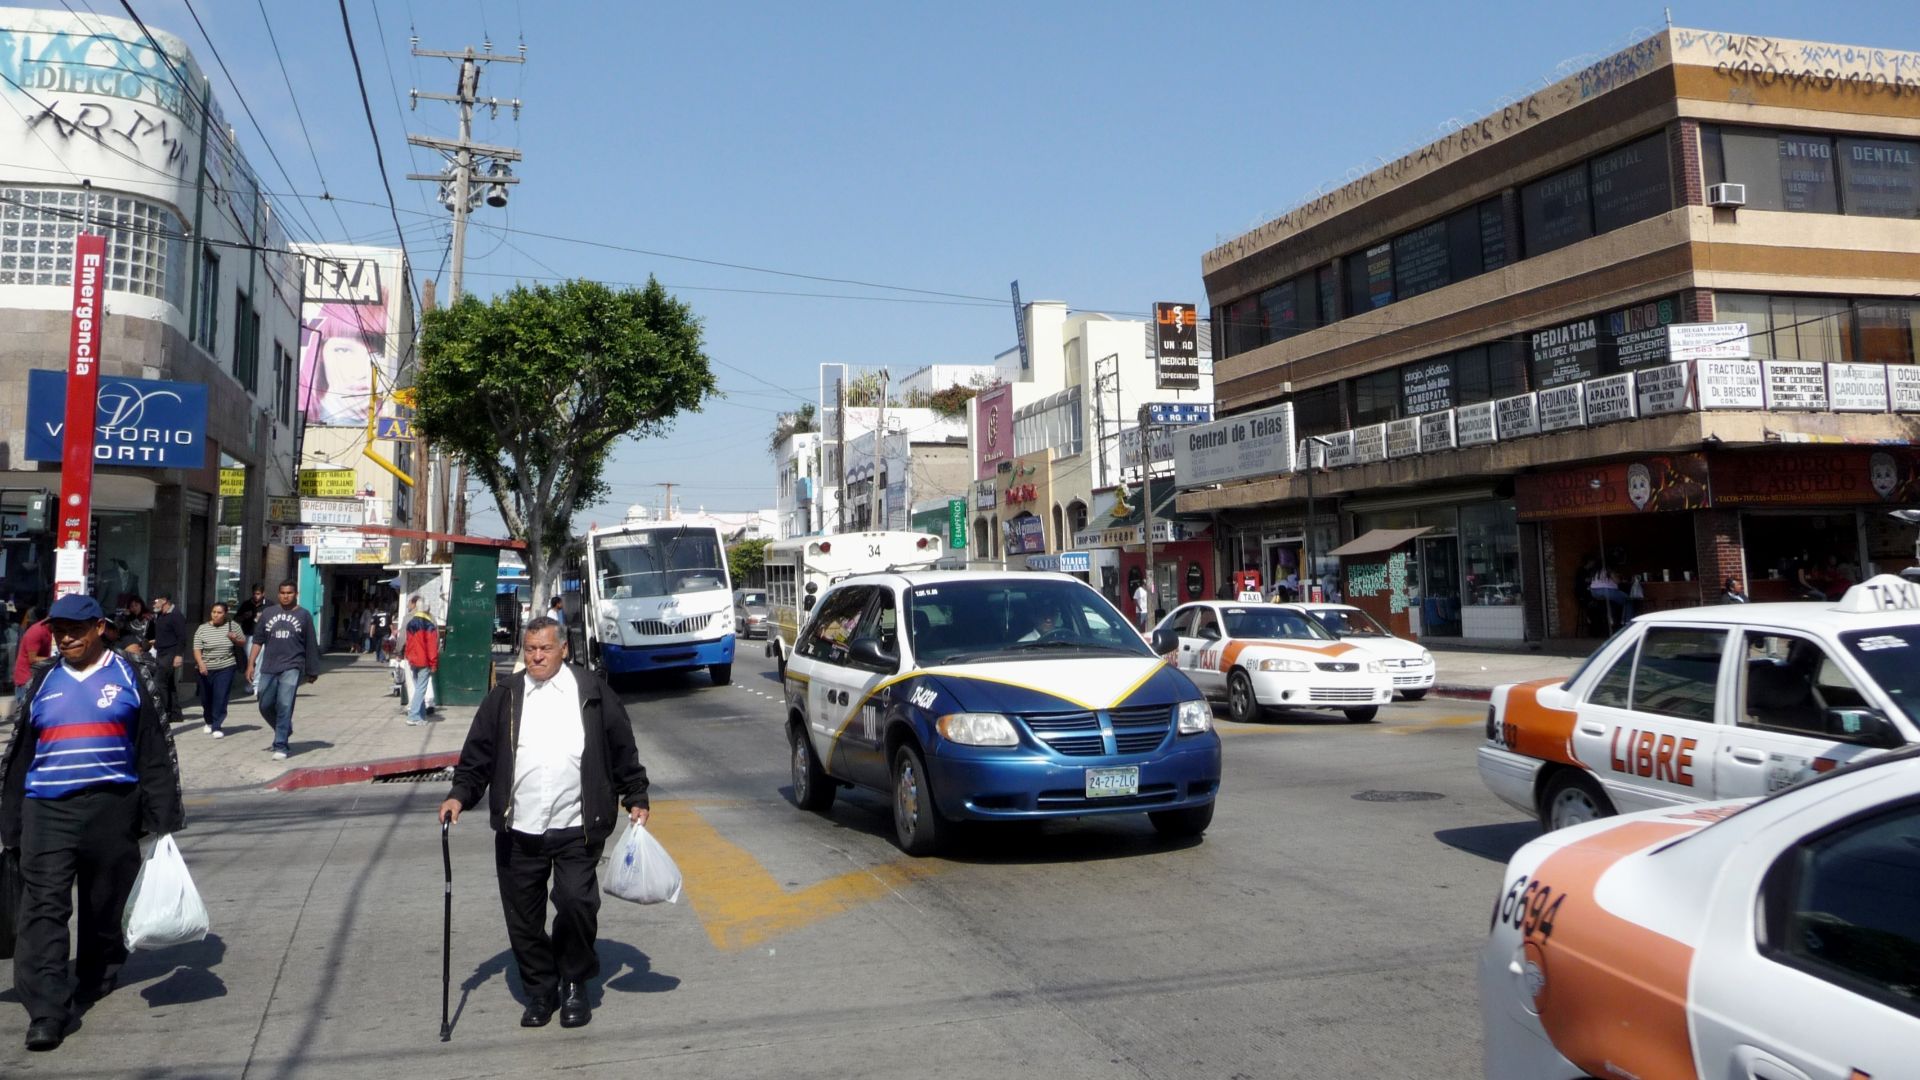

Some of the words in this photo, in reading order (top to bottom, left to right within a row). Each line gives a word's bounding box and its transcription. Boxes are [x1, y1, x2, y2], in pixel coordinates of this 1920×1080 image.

[20, 66, 142, 99] EDIFICIO
[1852, 146, 1913, 164] DENTAL
[1595, 152, 1643, 178] DENTAL
[76, 254, 100, 376] Emergencia
[1533, 319, 1596, 350] PEDIATRA
[1618, 339, 1665, 356] ADOLESCENTE
[1160, 356, 1187, 366] MEDICA
[1188, 357, 1198, 366] DE
[1708, 364, 1756, 374] FRACTURAS
[1770, 366, 1822, 375] DERMATOLOGIA
[1607, 375, 1627, 387] GENERAL
[1834, 382, 1885, 395] CARDIOLOGO
[1590, 386, 1626, 401] APARATO
[1800, 385, 1824, 393] PEELING
[1511, 396, 1531, 411] RECTO
[1541, 388, 1578, 406] PEDIATRAS
[1589, 398, 1629, 414] DIGESTIVO
[1500, 407, 1530, 422] INTESTINO
[46, 422, 192, 445] VTORIO
[1189, 426, 1228, 451] Central
[1231, 423, 1245, 443] de
[1249, 416, 1283, 438] Telas
[94, 444, 165, 462] ORTI
[310, 501, 337, 511] HECTOR
[344, 503, 363, 513] VEGA
[311, 512, 352, 523] DENTISTA
[868, 545, 881, 557] 34
[1062, 557, 1087, 565] VIAJES
[1243, 593, 1260, 601] TAXI
[1867, 583, 1920, 610] TAXI
[265, 613, 302, 632] AEROPOSTALE
[379, 617, 386, 627] 3
[1200, 650, 1217, 670] TAXI
[1610, 726, 1698, 787] LIBRE
